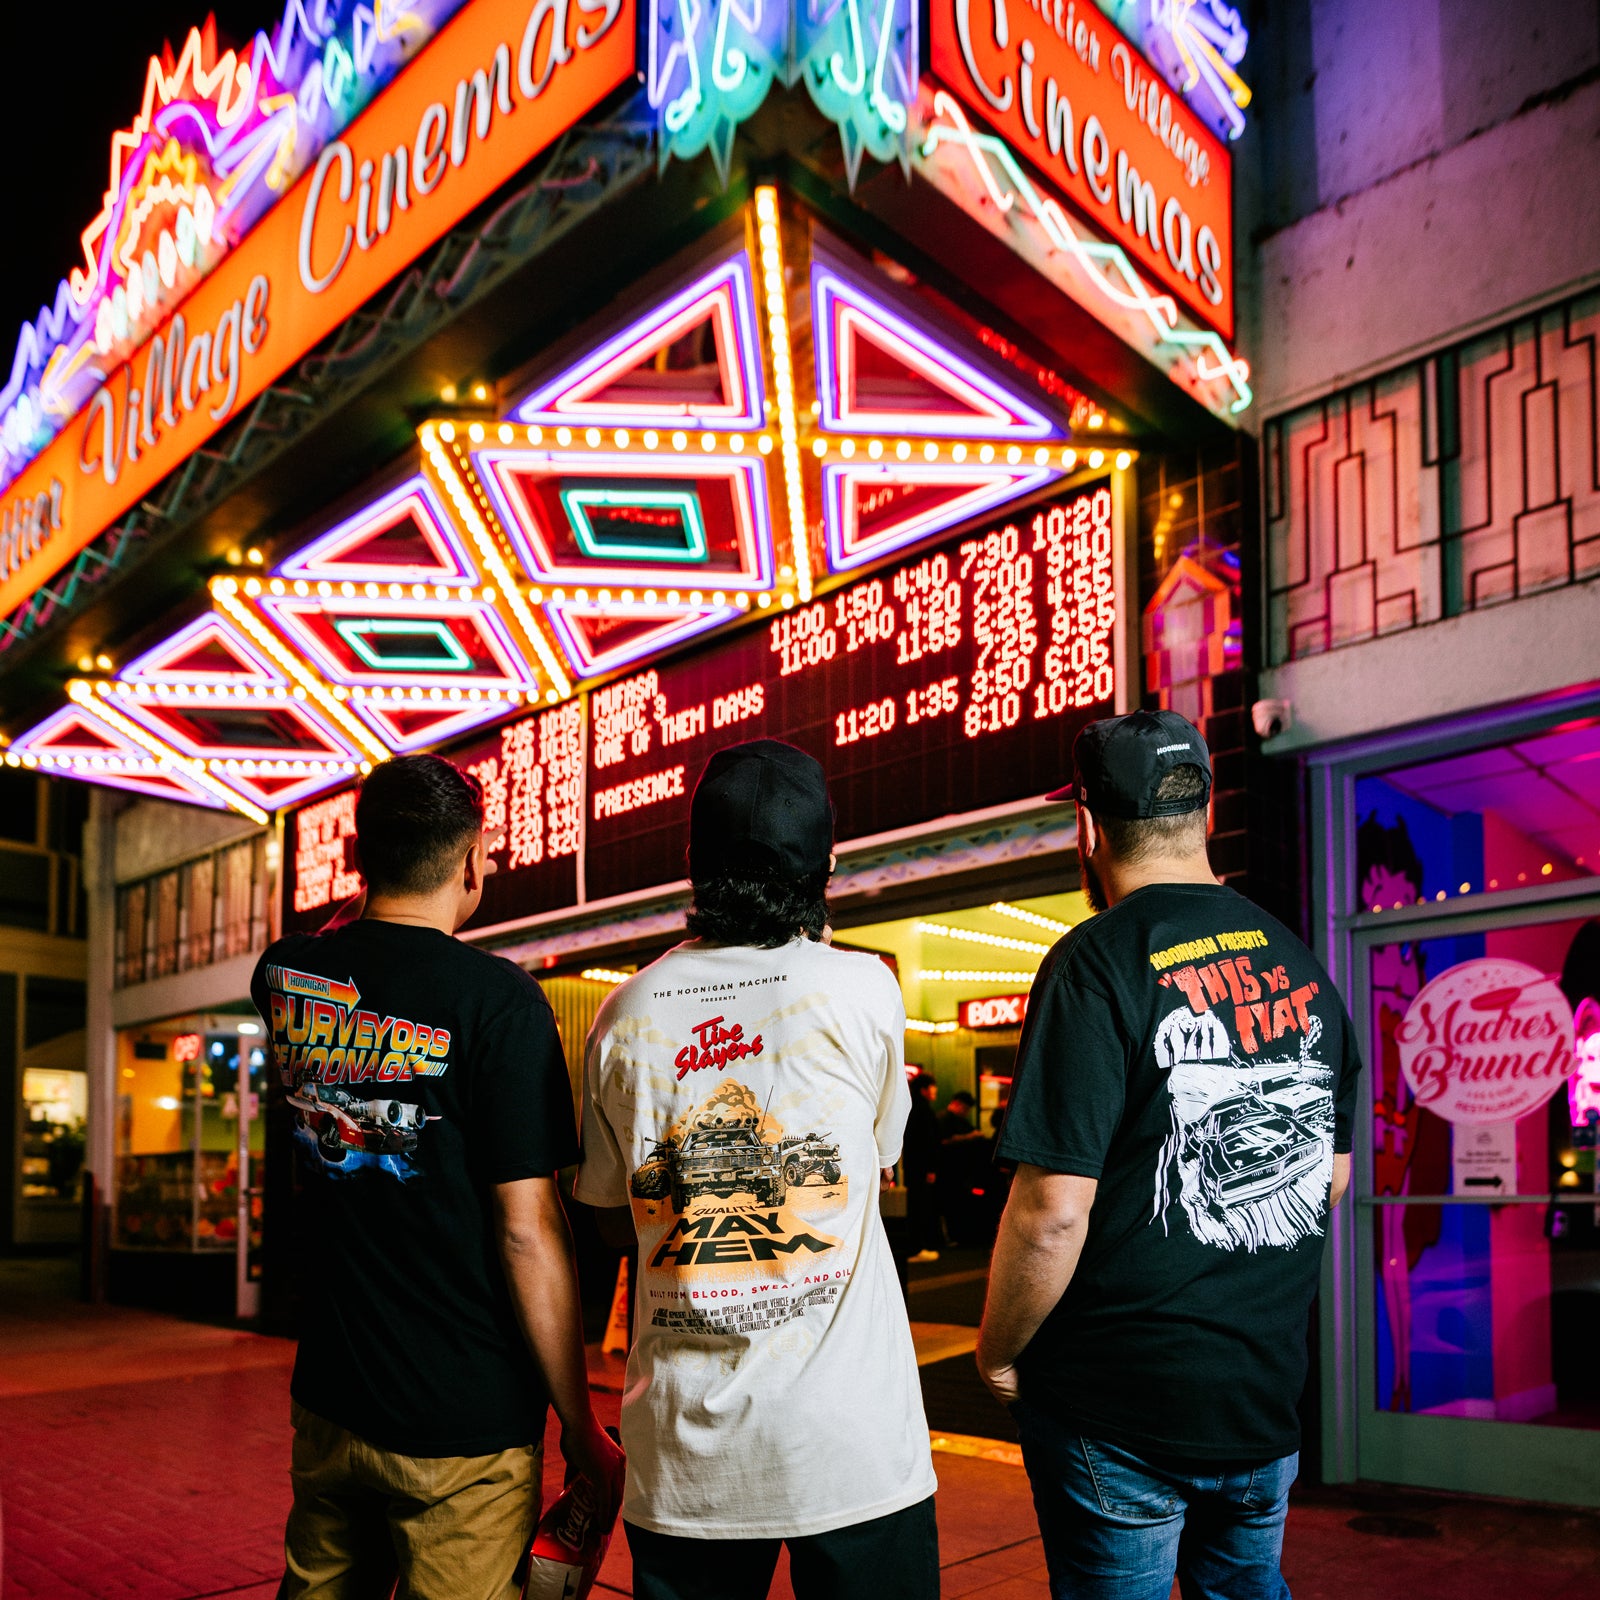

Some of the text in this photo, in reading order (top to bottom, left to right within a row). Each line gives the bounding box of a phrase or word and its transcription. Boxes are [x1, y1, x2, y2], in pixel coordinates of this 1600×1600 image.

[1111, 42, 1211, 188] Village
[955, 0, 1224, 306] Cinemas
[80, 275, 270, 485] Village
[300, 0, 622, 293] Cinemas
[771, 488, 1111, 651] 11:00 1:50 4:40 7:30 10:20
[780, 526, 1111, 676] 11:00 1:40 4:20 7:00 9:40
[897, 558, 1111, 664] 11:55 2:25 4:55
[977, 592, 1115, 669] 7:25 9:55
[653, 693, 667, 722] 3
[836, 630, 1109, 746] 11:20 1:35 3:50 6:05
[965, 664, 1114, 738] 8:10 10:20
[595, 683, 764, 769] ONE OF THEM DAYS
[1156, 743, 1191, 755] HOONIGAN
[1149, 929, 1269, 971] HOONIGAN PRESENTS
[653, 974, 789, 999] THE HOONIGAN MACHINE
[700, 994, 738, 1003] PRESENTS
[270, 991, 451, 1059] PURVEYORS
[691, 1015, 744, 1051] Tire
[967, 996, 1020, 1027] BOX
[1393, 999, 1559, 1047] Madres
[674, 1034, 764, 1081] Slayers
[1411, 1033, 1580, 1107] Brunch
[665, 1212, 785, 1242] MAY
[692, 1206, 757, 1217] QUALITY
[650, 1232, 837, 1268] HEM
[692, 1288, 744, 1299] BLOOD,
[804, 1273, 830, 1285] AND
[835, 1268, 852, 1279] OIL
[721, 1304, 744, 1316] OPERATES
[746, 1304, 751, 1312] A
[753, 1300, 768, 1311] MOTOR
[769, 1296, 789, 1308] VEHICLE
